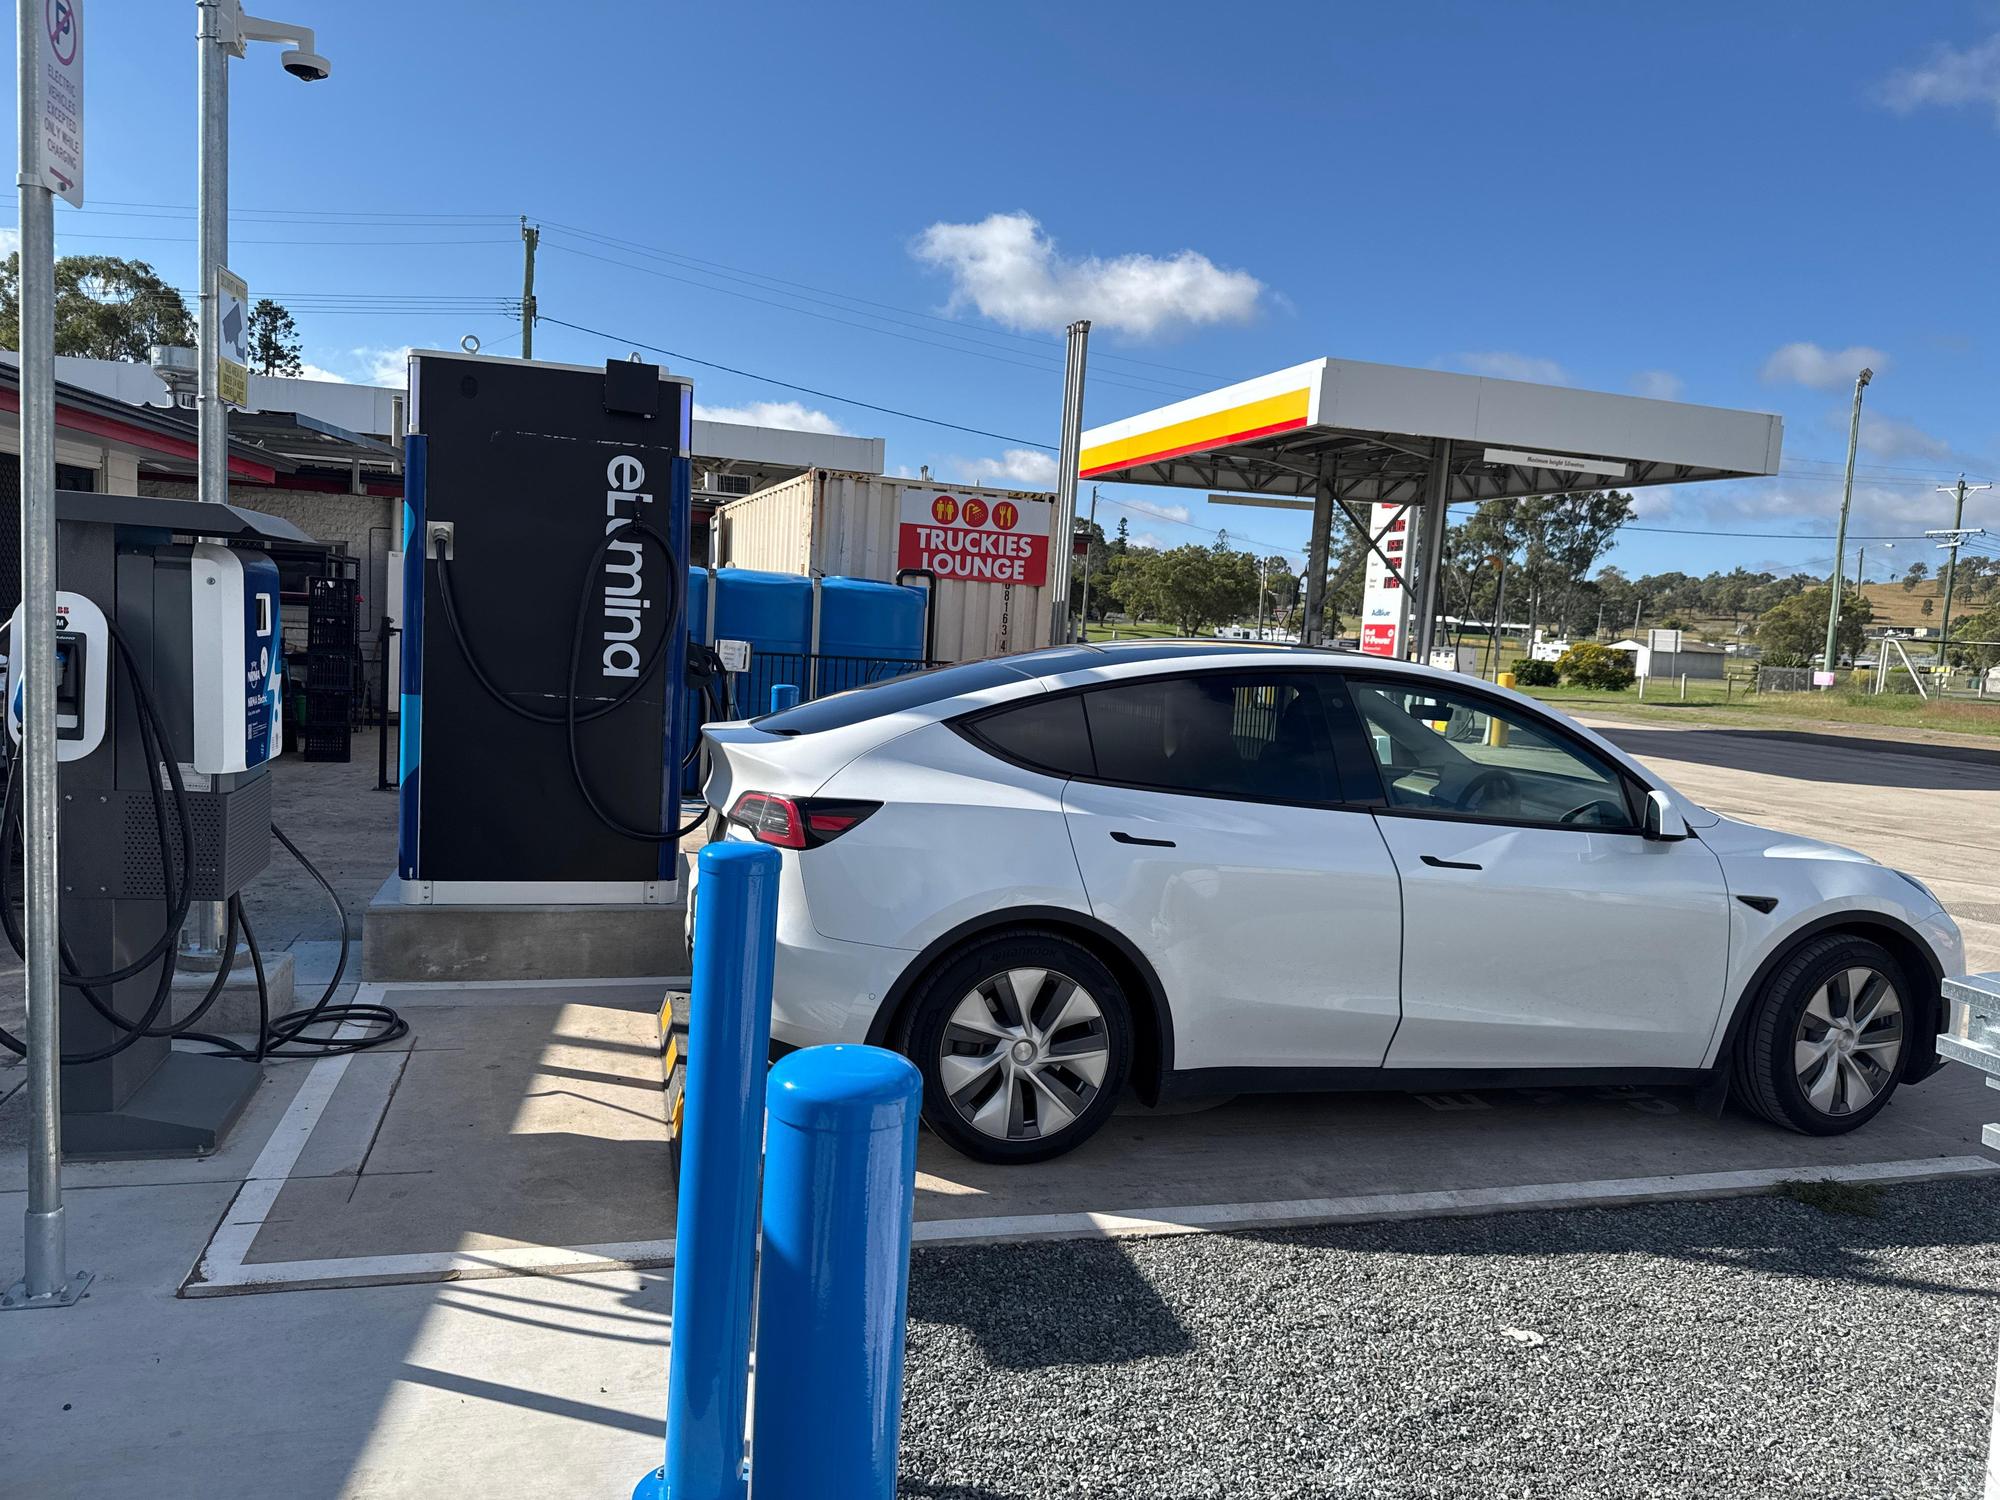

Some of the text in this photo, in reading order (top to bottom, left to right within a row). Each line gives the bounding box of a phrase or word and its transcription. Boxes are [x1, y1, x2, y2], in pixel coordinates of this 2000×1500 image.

[47, 63, 76, 98] ELECTRIC
[47, 81, 76, 116] VEHICLES
[46, 99, 77, 134] EXCEPTED
[44, 116, 79, 154] ONLY WHILE
[47, 138, 77, 170] CHARGING
[917, 528, 1032, 557] TRUCKIES
[922, 552, 1025, 580] LOUNGE
[56, 606, 70, 614] BB
